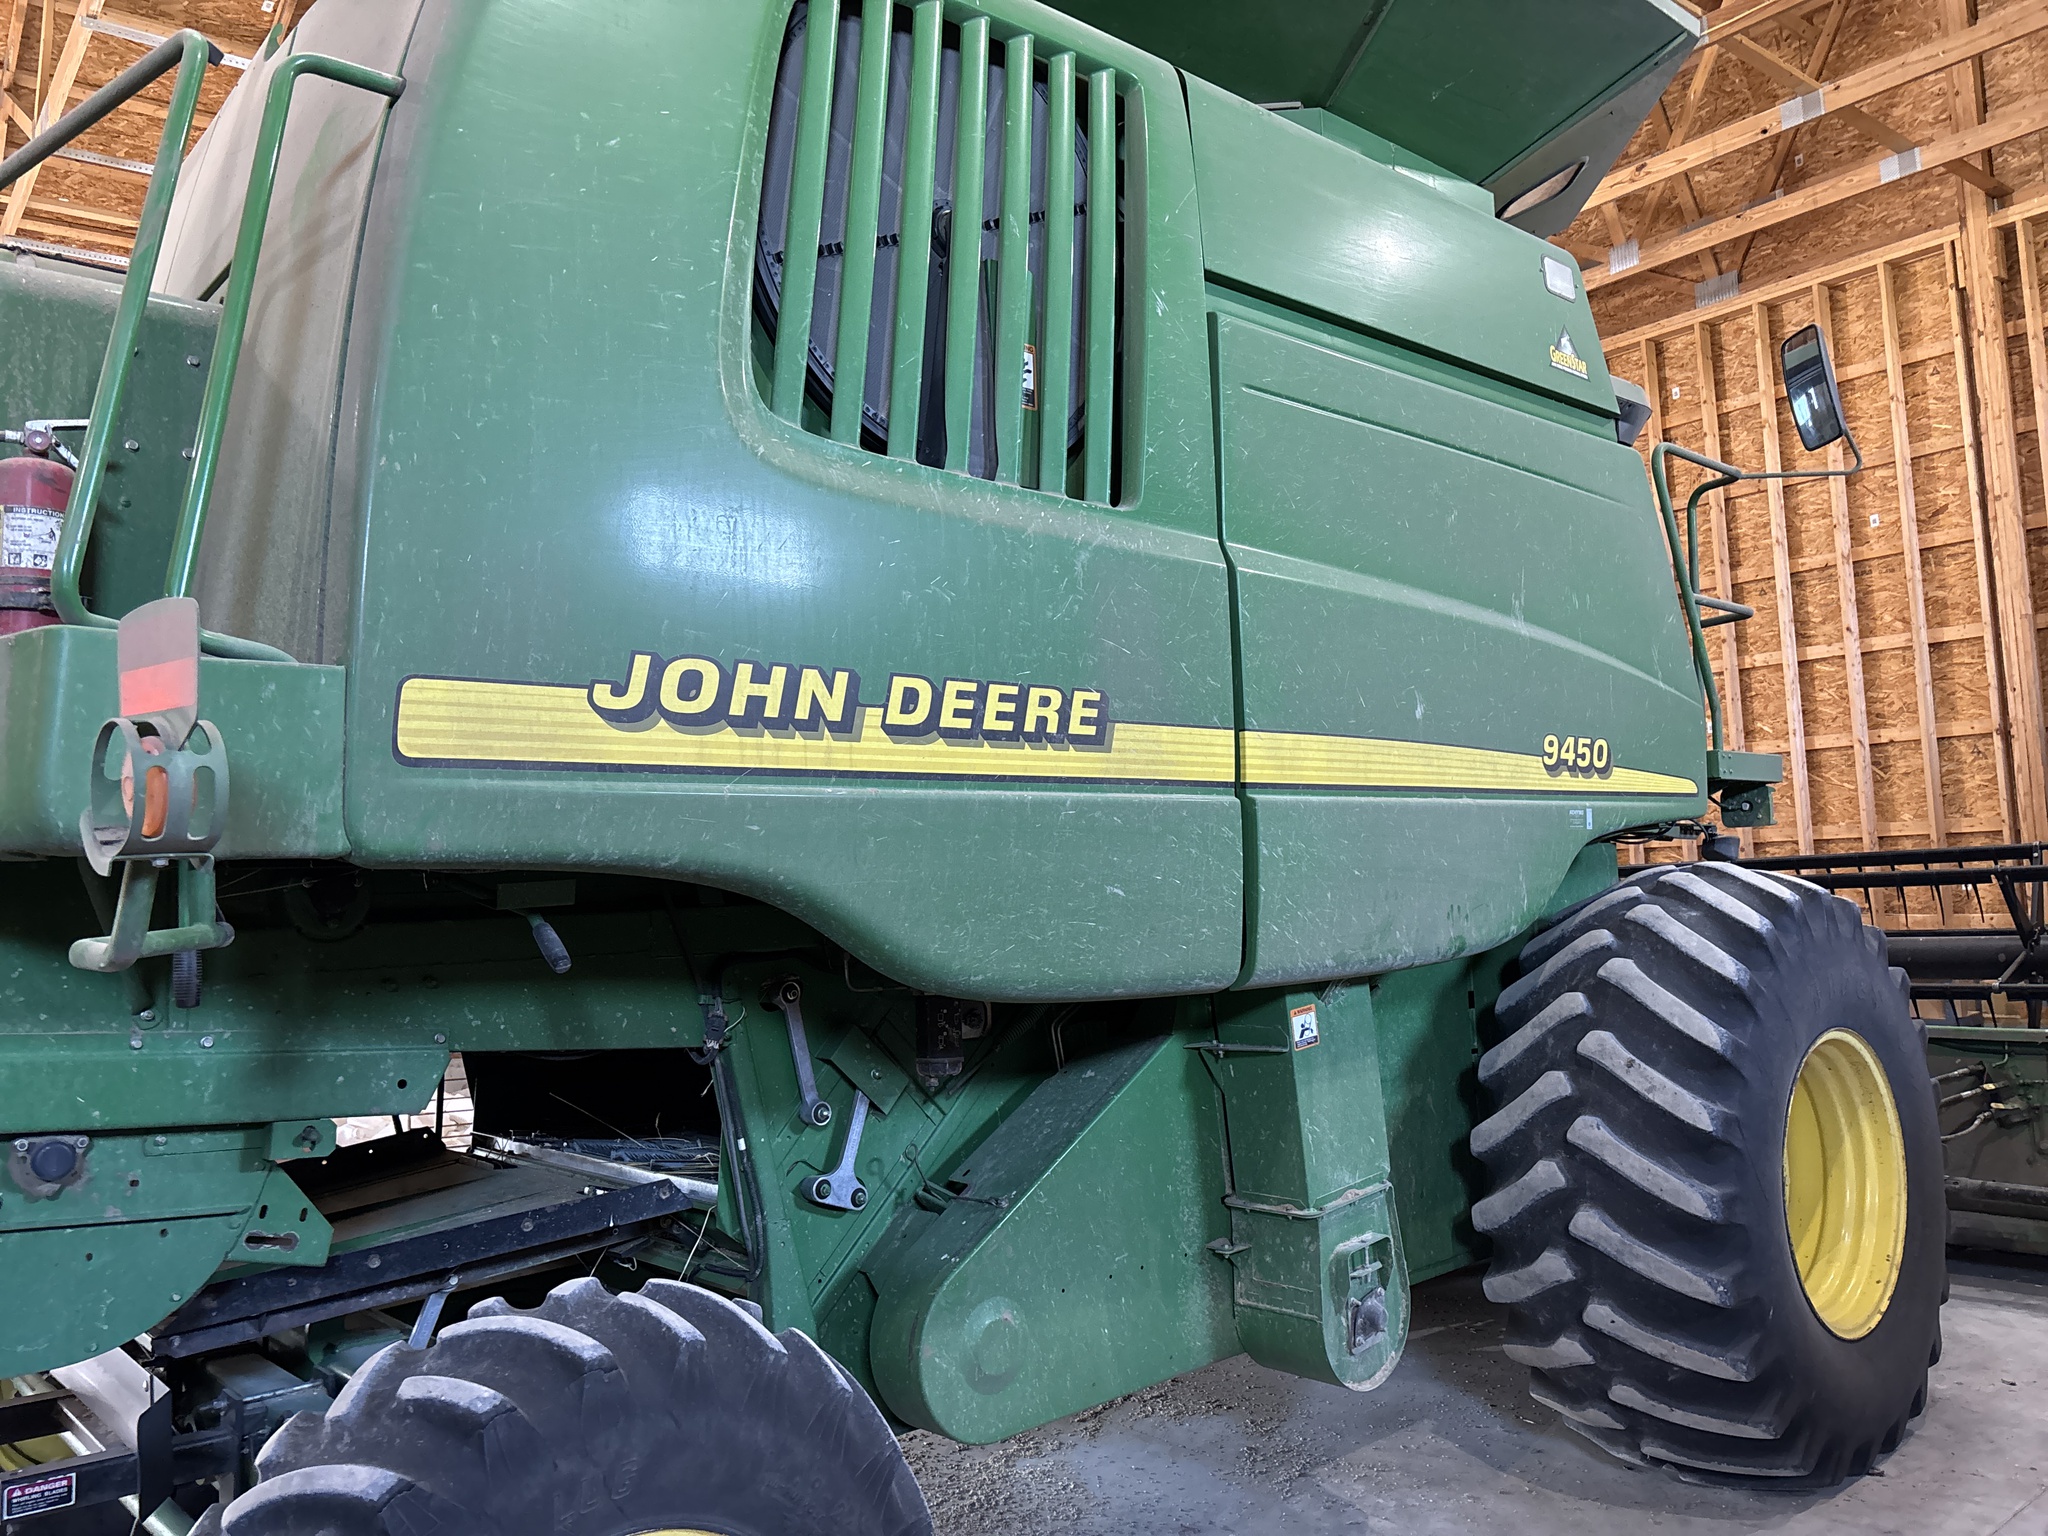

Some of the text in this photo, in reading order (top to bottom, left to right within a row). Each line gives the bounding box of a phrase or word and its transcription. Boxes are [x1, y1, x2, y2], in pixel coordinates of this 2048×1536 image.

[589, 651, 1108, 746] JOHN DEERE
[1542, 733, 1612, 774] 9450
[11, 1492, 42, 1503] WHIRLING
[44, 1486, 69, 1497] BLADES
[24, 1479, 68, 1495] DANGER
